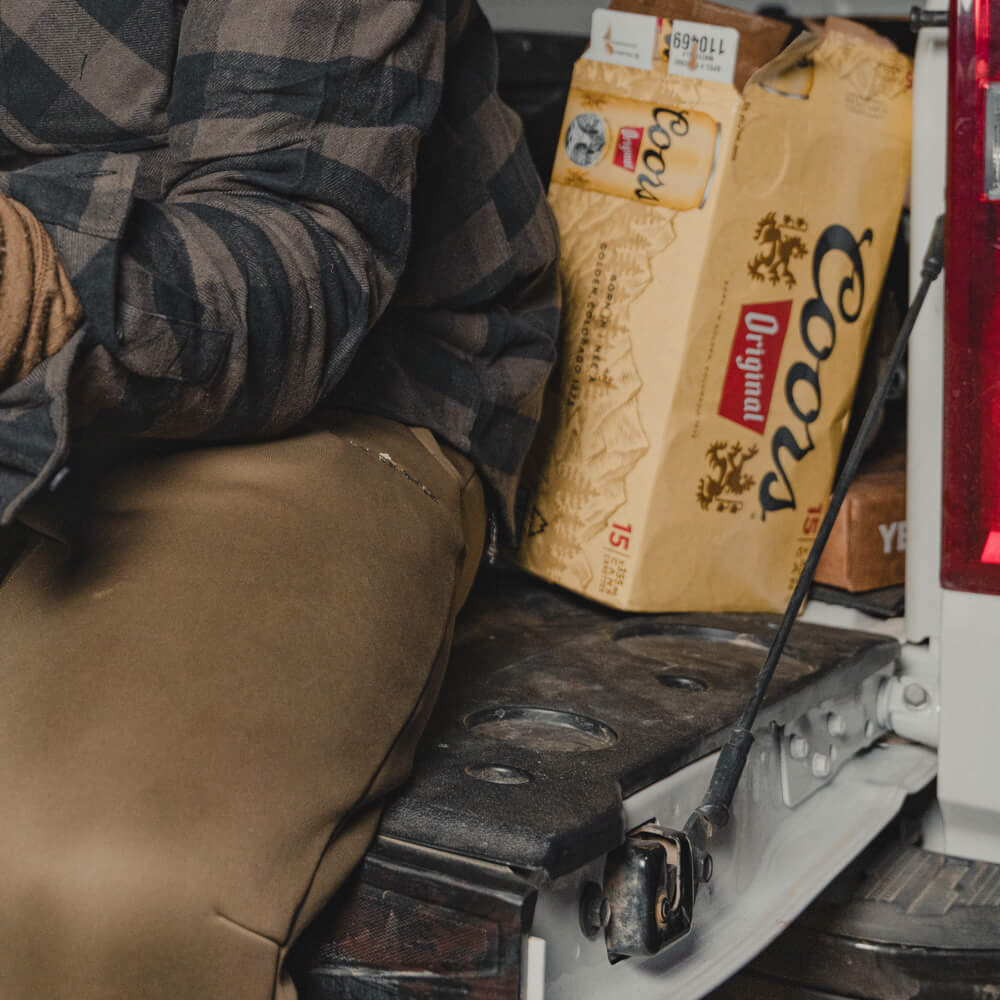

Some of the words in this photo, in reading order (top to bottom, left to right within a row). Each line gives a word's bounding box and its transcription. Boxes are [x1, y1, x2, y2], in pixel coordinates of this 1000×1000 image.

[634, 106, 690, 202] Coors
[736, 311, 780, 424] Original
[759, 224, 874, 522] Coors
[609, 522, 632, 551] 15
[802, 503, 823, 535] 15
